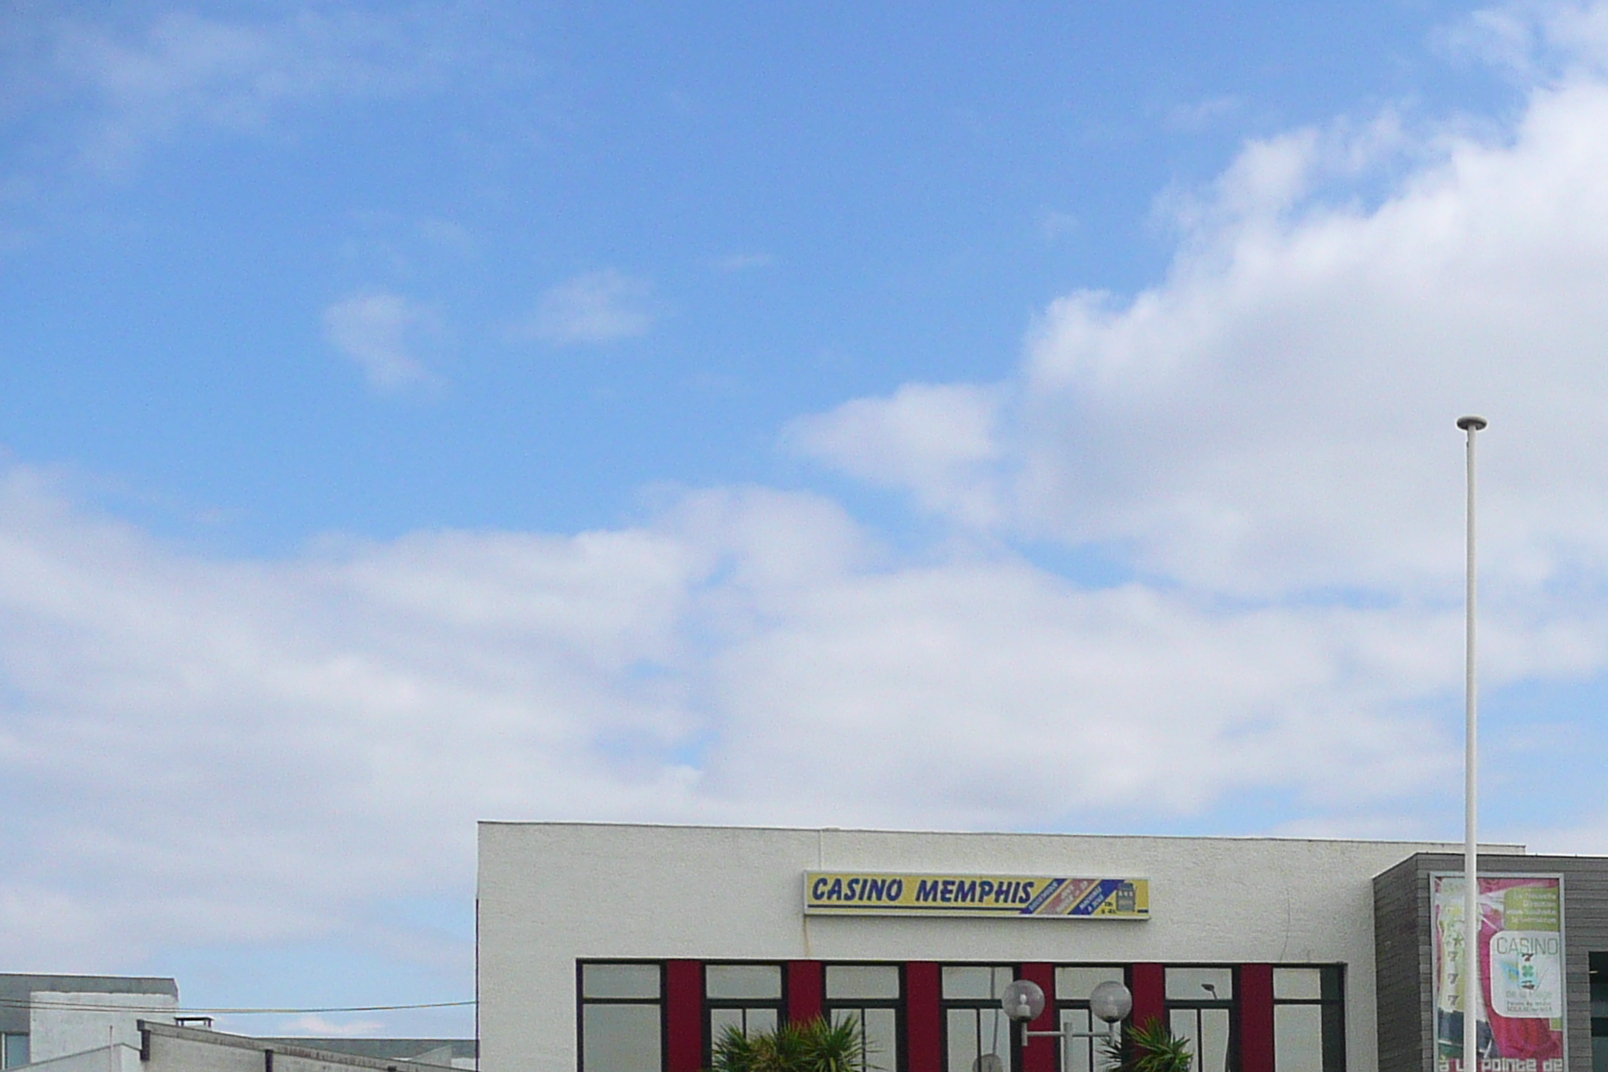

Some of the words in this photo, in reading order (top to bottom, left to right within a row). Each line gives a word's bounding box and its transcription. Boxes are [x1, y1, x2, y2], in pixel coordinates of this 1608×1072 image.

[811, 877, 903, 901] CASINO
[915, 879, 1035, 904] MEMPHIS
[1496, 937, 1558, 956] CASINO
[1543, 1057, 1563, 1072] de
